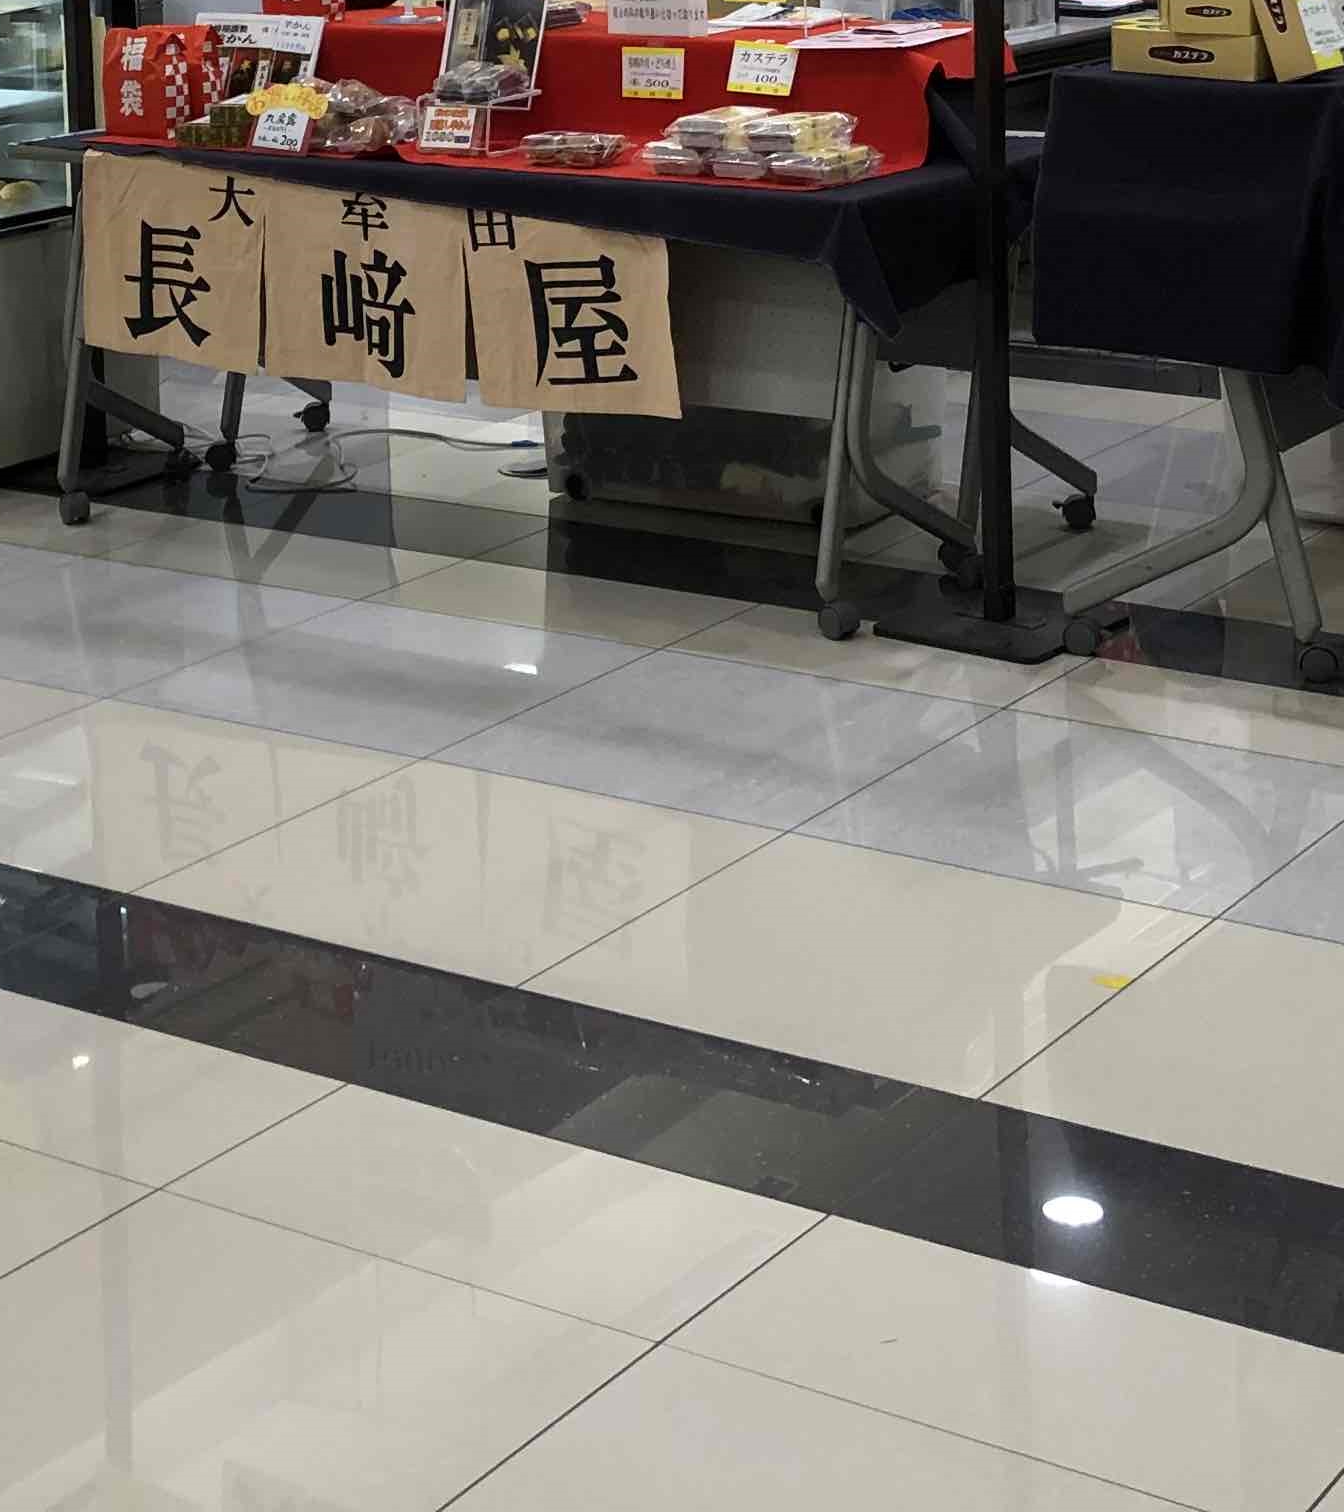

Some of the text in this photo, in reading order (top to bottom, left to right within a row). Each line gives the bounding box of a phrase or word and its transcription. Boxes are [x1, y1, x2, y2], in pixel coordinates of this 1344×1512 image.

[120, 37, 147, 117] 福袋
[741, 50, 788, 66] カステラ
